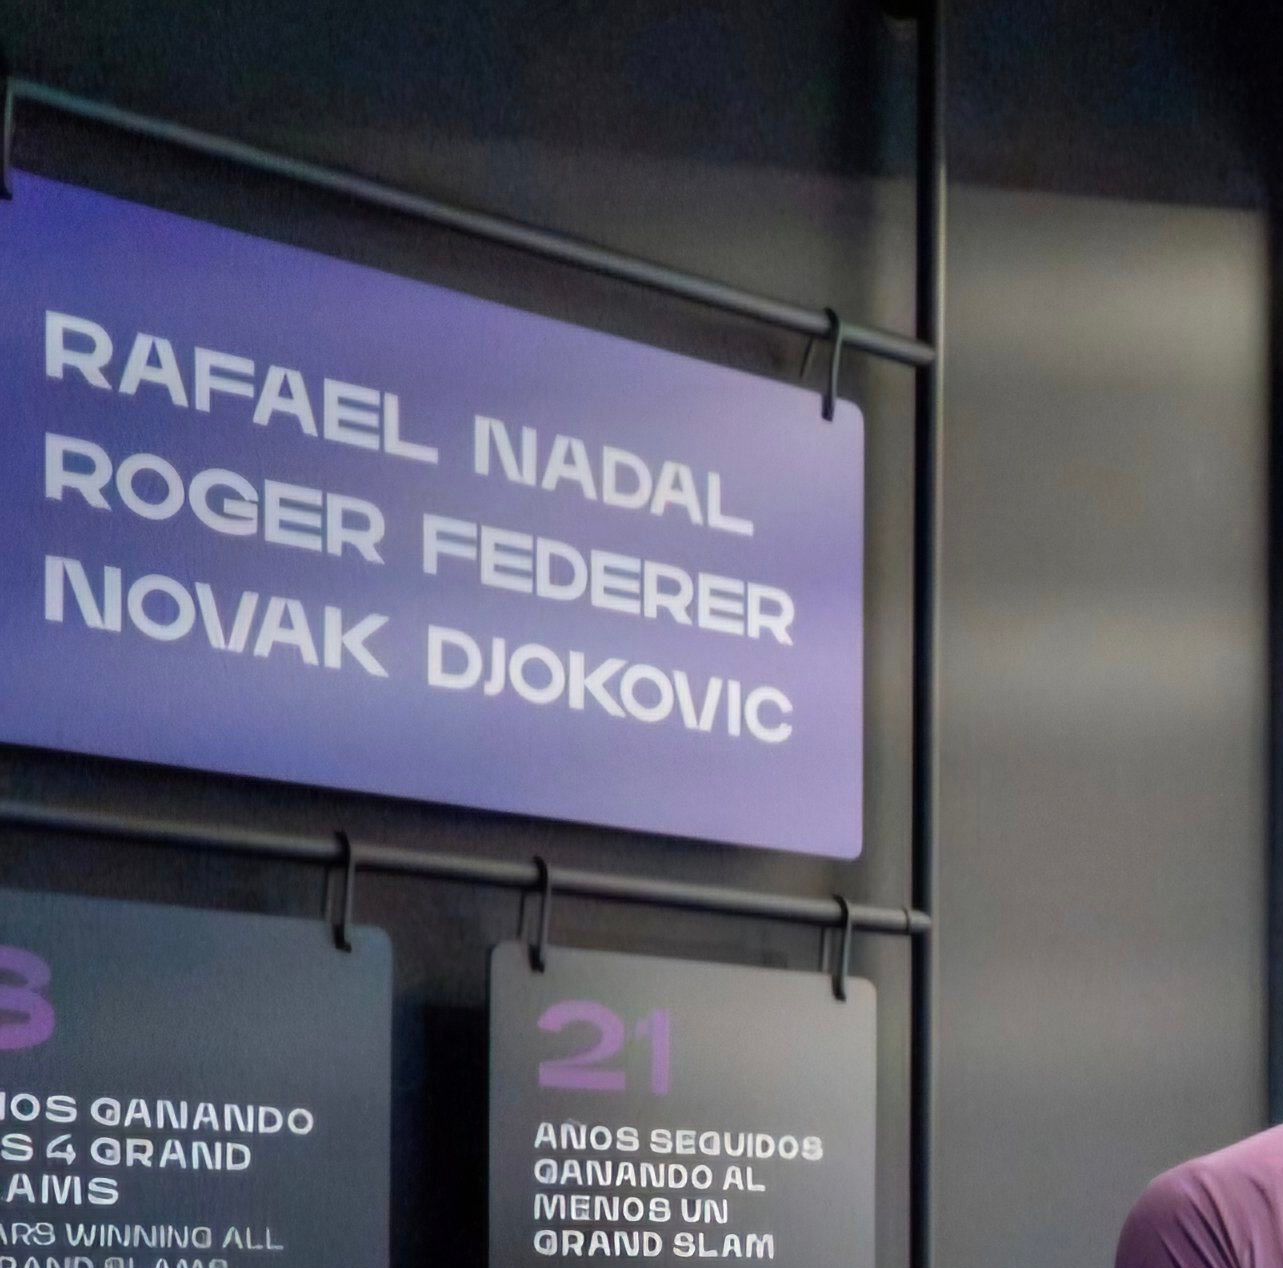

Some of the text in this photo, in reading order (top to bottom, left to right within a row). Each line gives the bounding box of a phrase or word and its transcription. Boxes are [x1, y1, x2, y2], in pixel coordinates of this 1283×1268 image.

[44, 310, 755, 537] RAFAEL NADAL
[44, 433, 796, 647] ROGER FEDERER
[44, 555, 793, 744] NOVAK DJOKOVIC
[537, 999, 670, 1095] 21
[0, 1092, 313, 1135] OS GANANDO
[46, 1133, 76, 1166] 4
[90, 1137, 251, 1170] GRAND
[650, 1129, 823, 1161] SEGUIDOS
[534, 1158, 766, 1192] GANANDO AL
[534, 1193, 728, 1224] MENOS UN
[65, 1223, 212, 1249] WINNING
[222, 1226, 284, 1250] ALL
[533, 1229, 774, 1260] GRAND SLAM
